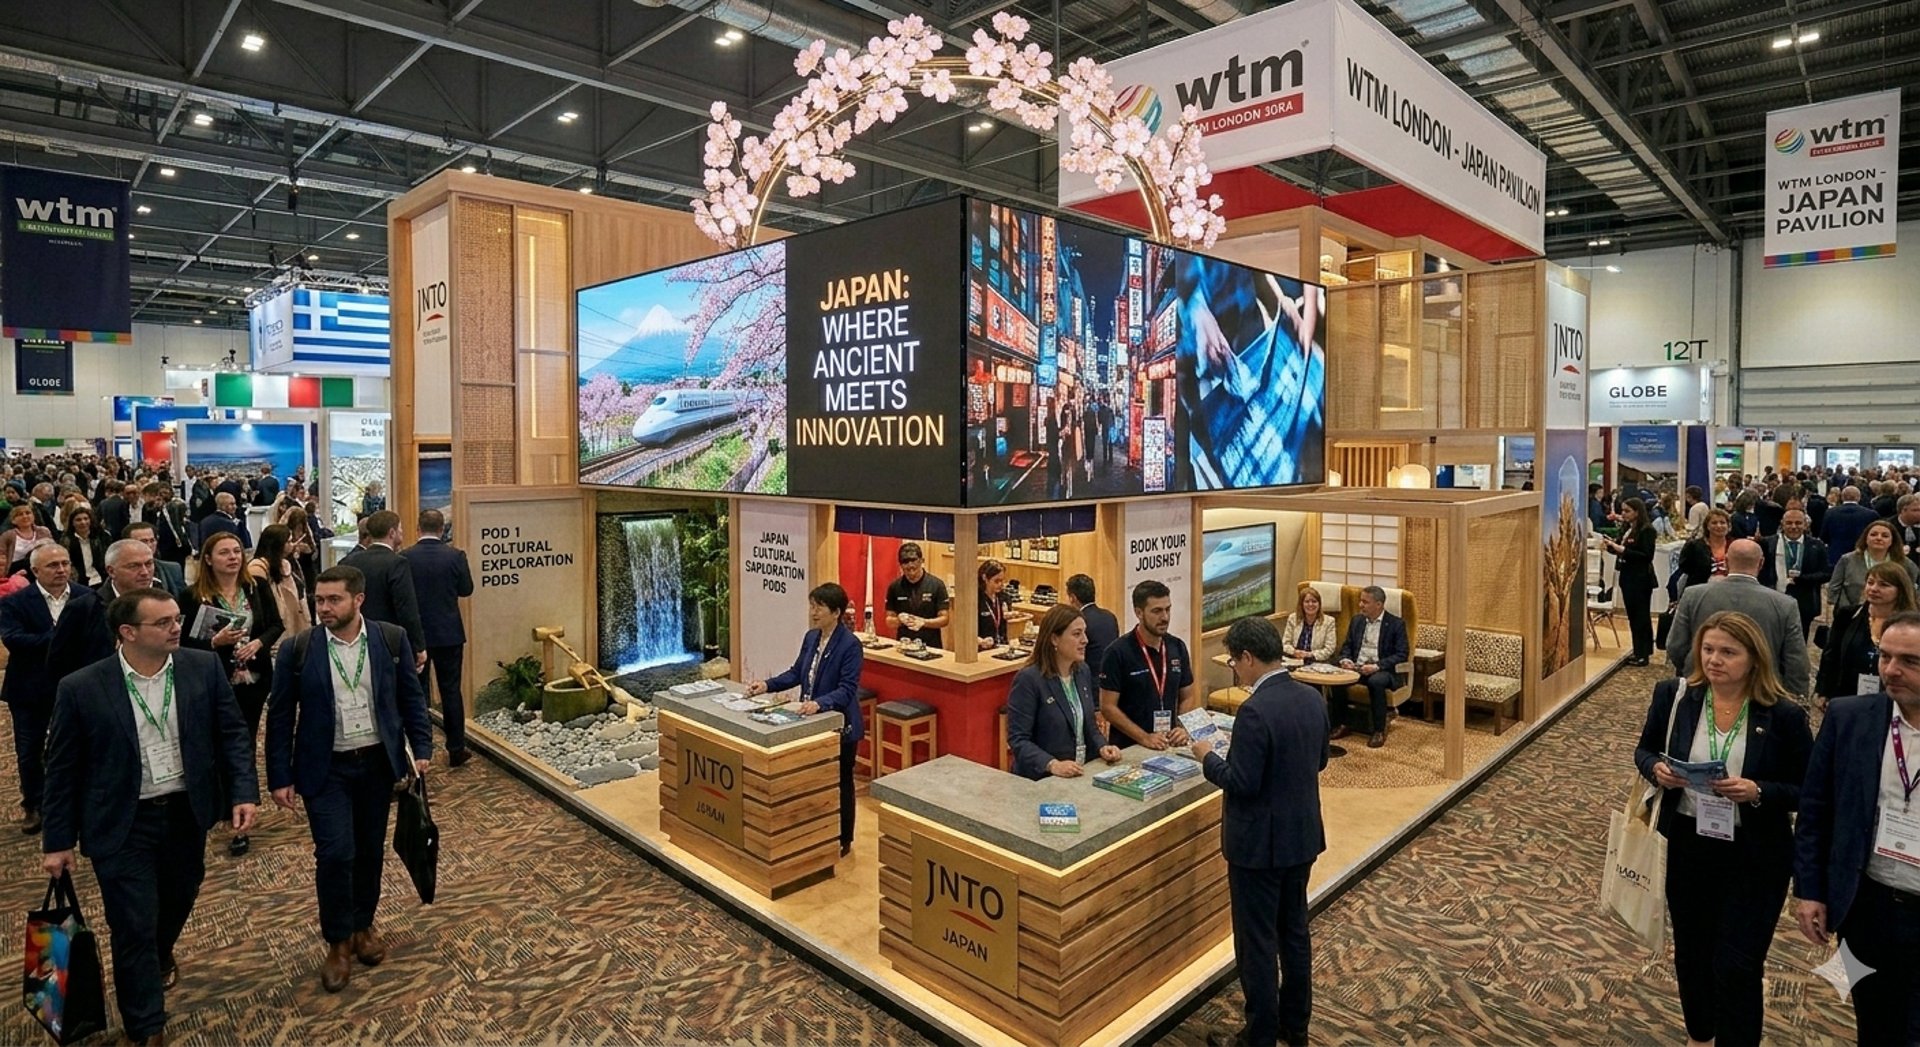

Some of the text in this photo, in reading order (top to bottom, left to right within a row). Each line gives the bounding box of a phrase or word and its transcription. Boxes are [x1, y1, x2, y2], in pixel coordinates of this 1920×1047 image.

[1175, 49, 1303, 112] wtm
[1346, 57, 1388, 119] WTM
[1393, 90, 1452, 160] LONDON
[1461, 141, 1498, 188] JAPAN
[1499, 164, 1541, 215] PAVILION
[1810, 117, 1885, 144] wtm
[1778, 177, 1812, 190] WTM
[1815, 168, 1876, 186] LONDON
[15, 197, 114, 229] wtm
[1778, 182, 1883, 215] JAPAN
[1776, 208, 1884, 235] PAVILION
[417, 281, 447, 331] JNTO
[820, 269, 910, 311] JAPAN:
[822, 305, 909, 344] WHERE
[813, 340, 920, 379] ANCIENT
[1553, 322, 1584, 378] JNTO
[1663, 339, 1709, 361] 12T
[825, 379, 908, 412] MEETS
[1609, 385, 1667, 398] GLOBE
[795, 414, 944, 447] INNOVATION
[481, 526, 520, 540] POD 1
[481, 540, 553, 556] COLTURAL
[760, 531, 789, 546] JAPAN
[1130, 533, 1186, 555] BOOK YOUR
[481, 553, 574, 572] EXPLORATION
[481, 573, 520, 587] PODS
[763, 578, 787, 594] PODS
[684, 748, 734, 790] JNTO
[924, 858, 1004, 921] JNTO
[942, 927, 988, 963] JAPAN
